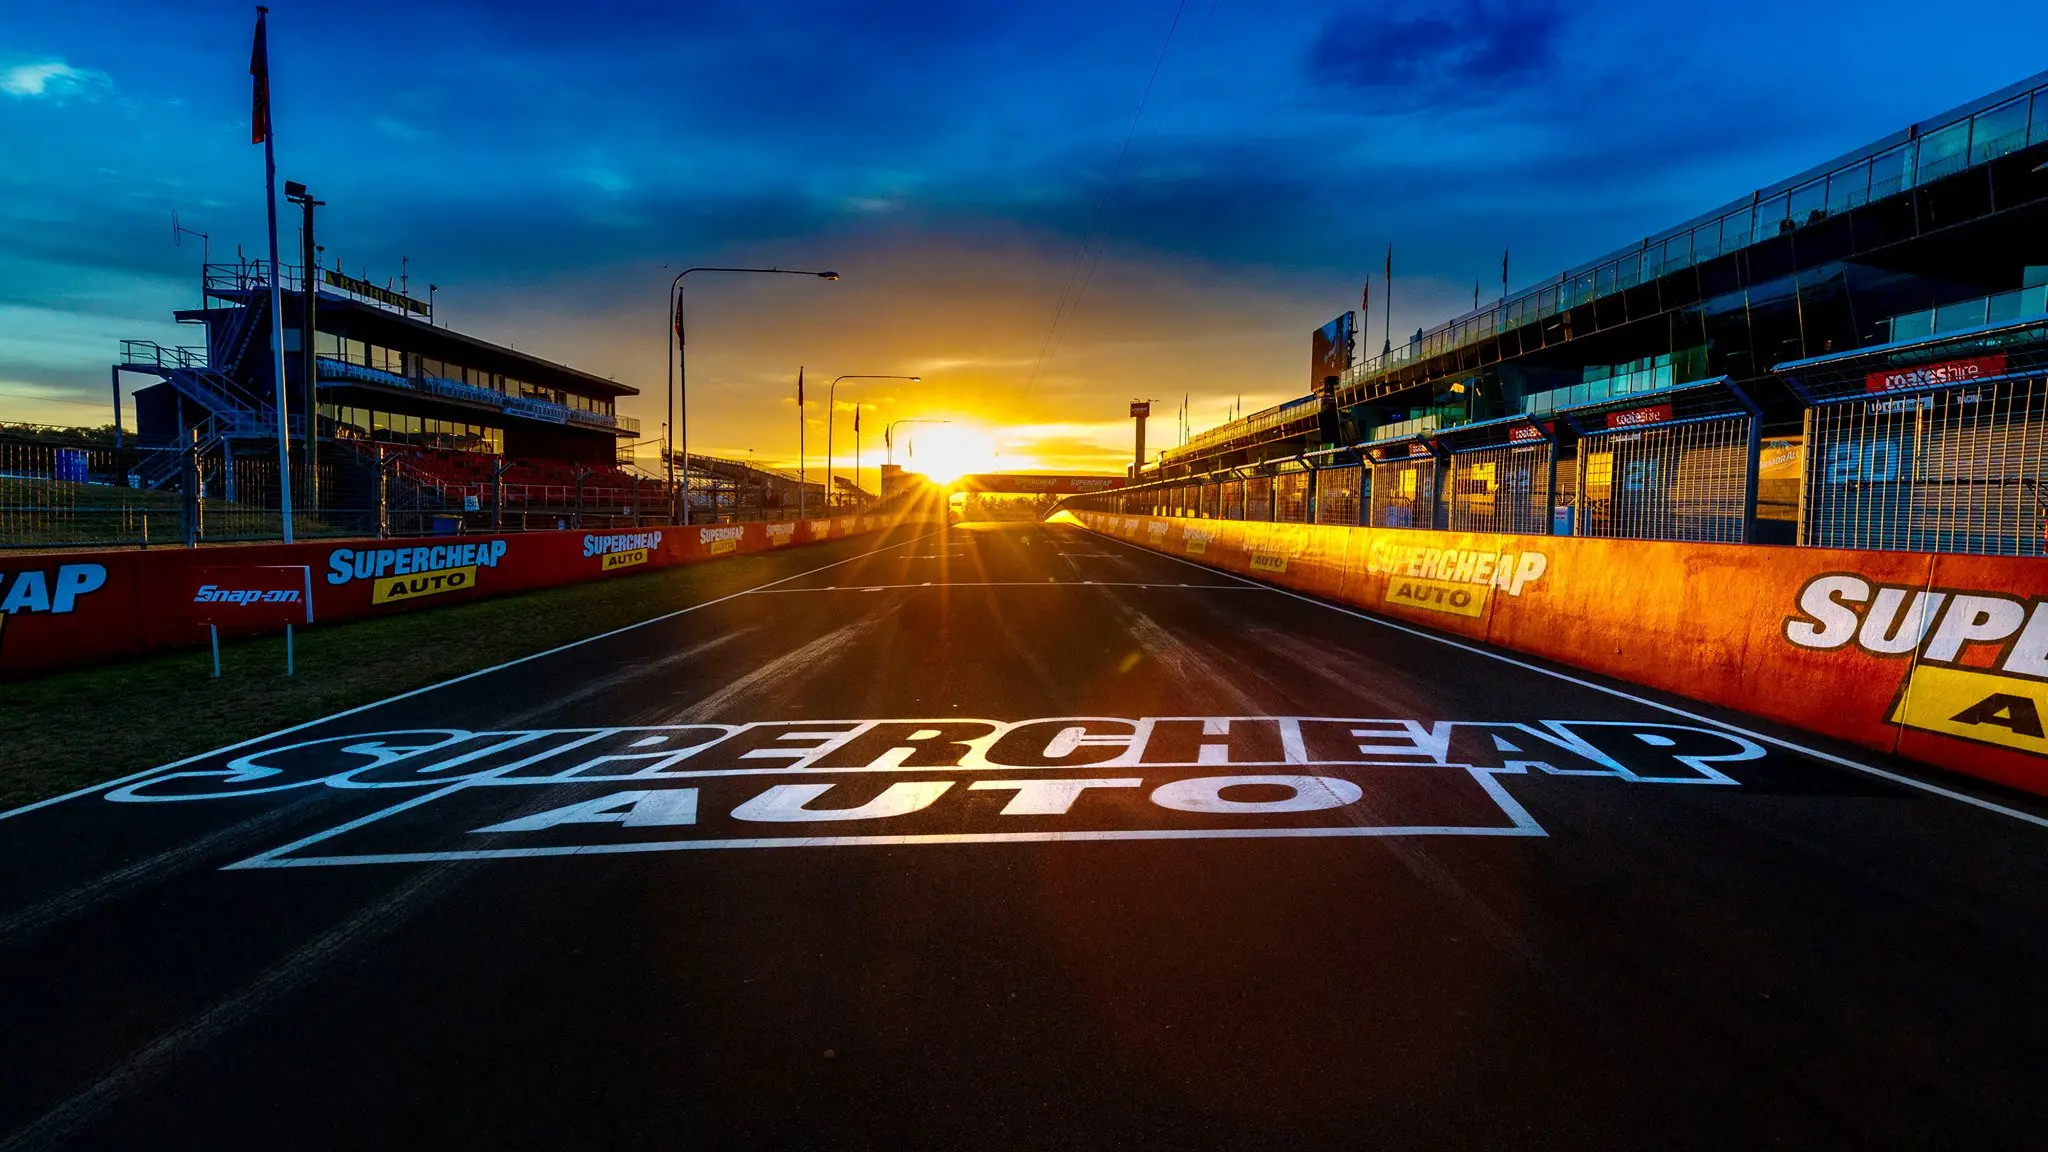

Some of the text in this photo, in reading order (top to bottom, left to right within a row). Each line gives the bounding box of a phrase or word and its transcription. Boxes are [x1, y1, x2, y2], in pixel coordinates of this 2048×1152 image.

[583, 530, 662, 557] SUPERCHEAP
[700, 525, 744, 544] SUPERCHEAP
[327, 540, 507, 585] SUPERCHEAP
[608, 553, 644, 567] AUTO
[1255, 555, 1283, 568] AUTO
[1367, 542, 1547, 597] SUPERCHEAP
[0, 563, 107, 614] AP
[387, 572, 466, 598] AUTO
[1396, 582, 1473, 608] AUTO
[104, 717, 1767, 803] SUPERCHEAP
[466, 773, 1364, 834] AUTO
